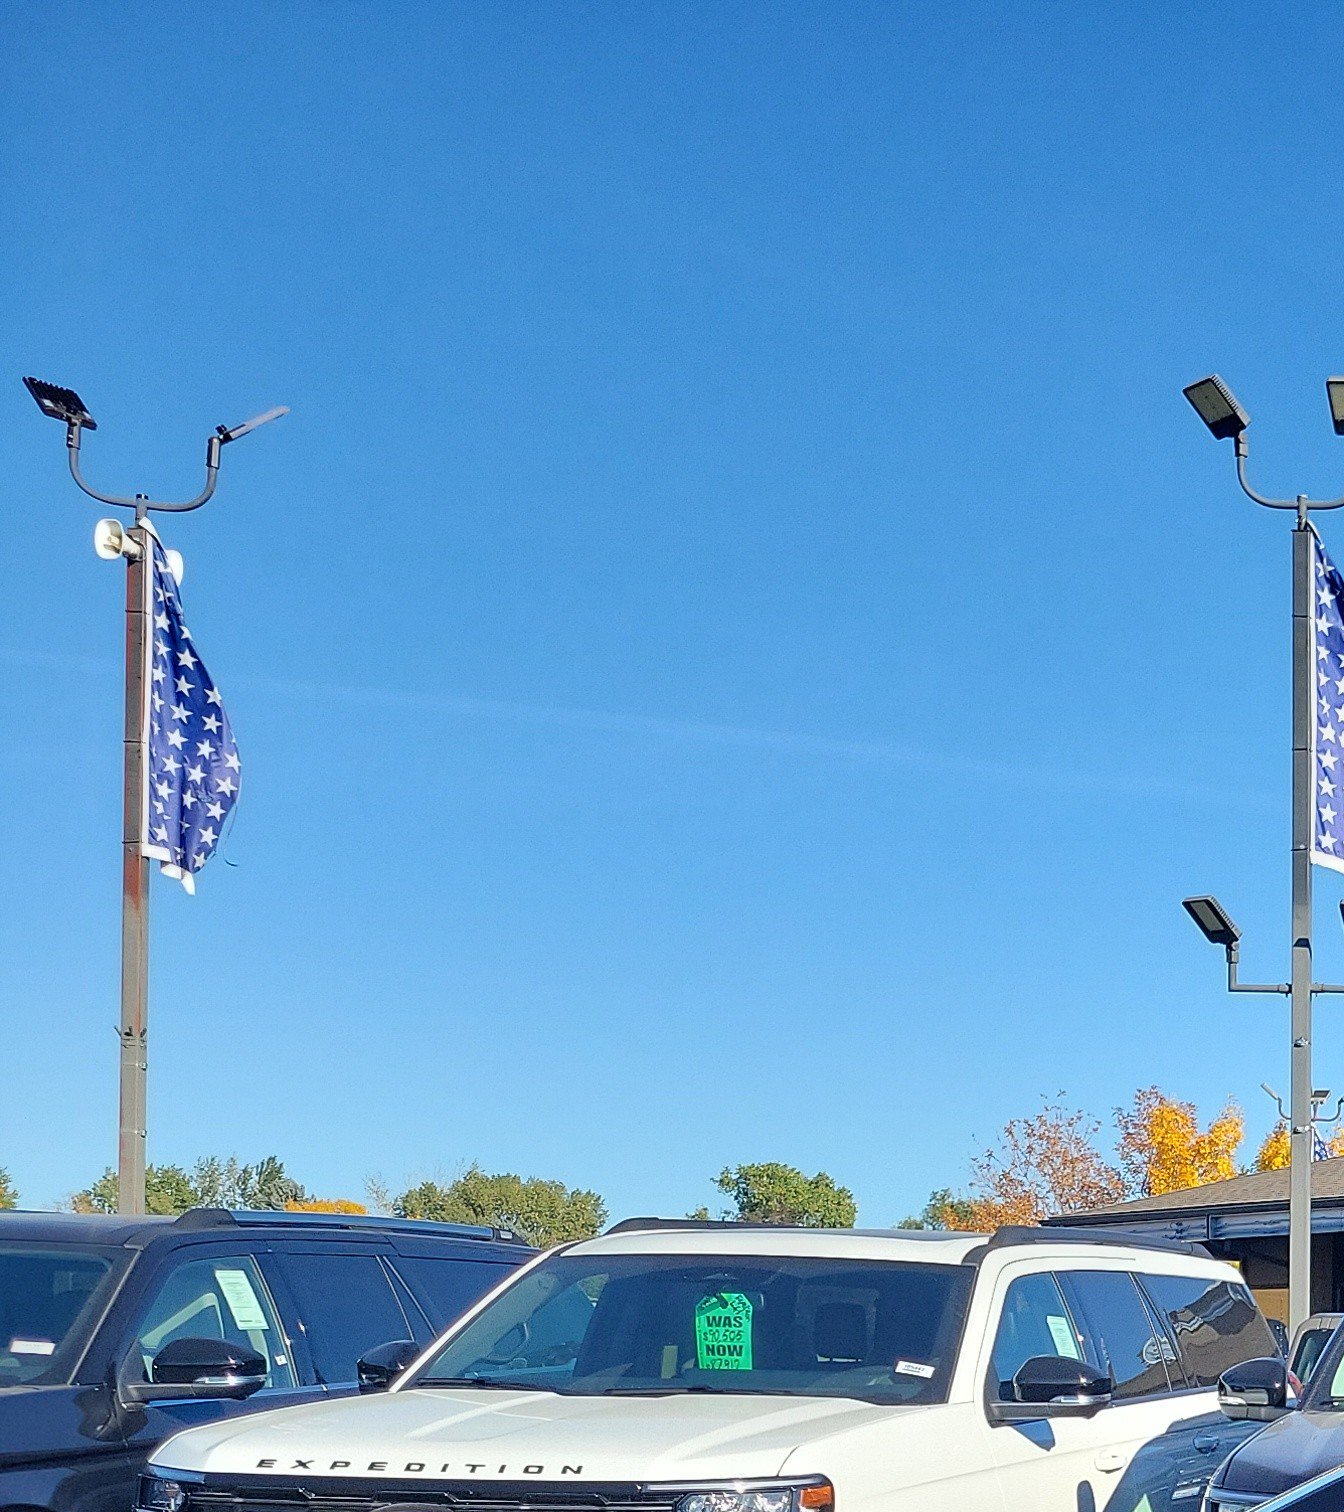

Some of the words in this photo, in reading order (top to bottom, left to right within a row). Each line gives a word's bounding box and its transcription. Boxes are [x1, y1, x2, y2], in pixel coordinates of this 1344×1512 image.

[706, 1315, 743, 1328] WAS
[705, 1344, 743, 1357] NOW
[256, 1459, 584, 1475] EXPEDITION
